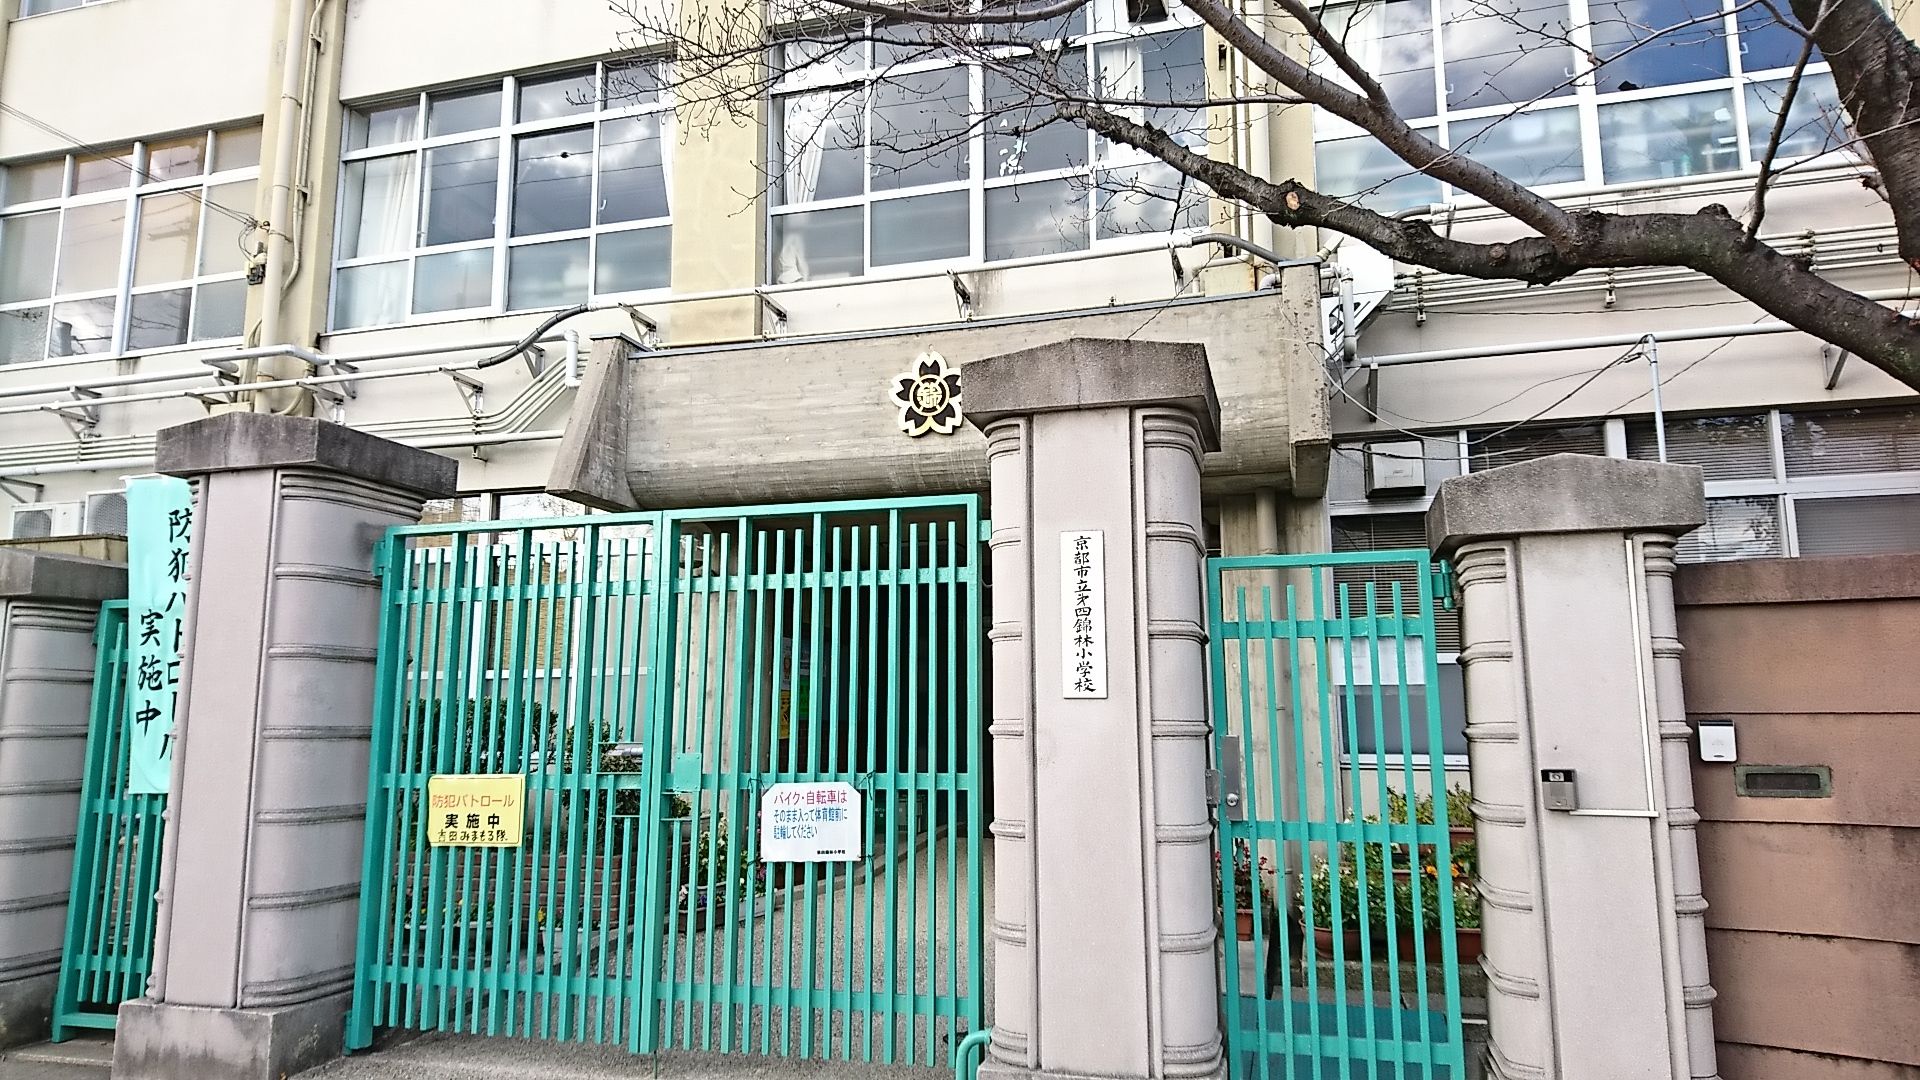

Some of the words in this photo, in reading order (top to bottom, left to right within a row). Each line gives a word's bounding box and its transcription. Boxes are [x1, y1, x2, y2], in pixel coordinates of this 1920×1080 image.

[136, 609, 163, 737] 実施中
[432, 794, 515, 808] 防犯パトロール
[774, 790, 848, 805] バイク・自転車は
[445, 813, 499, 829] 実施中
